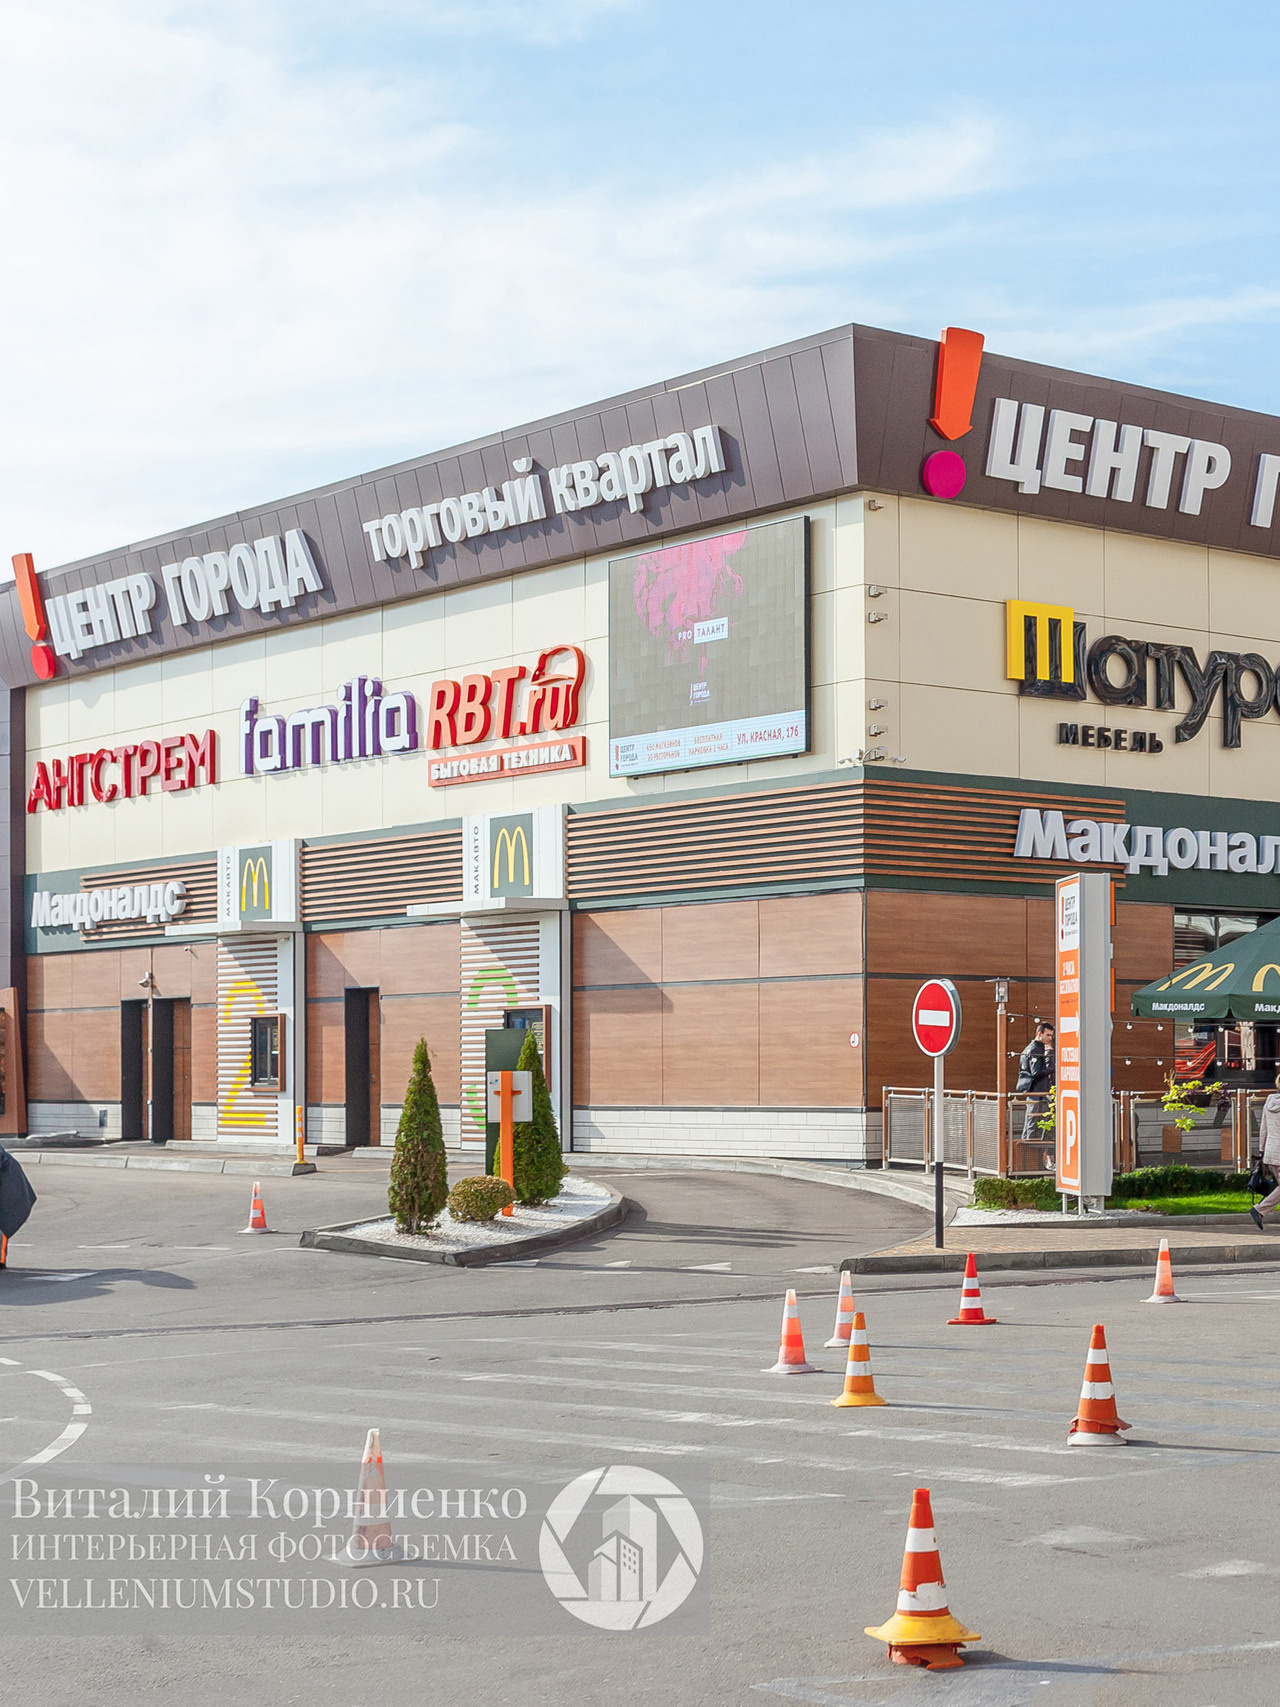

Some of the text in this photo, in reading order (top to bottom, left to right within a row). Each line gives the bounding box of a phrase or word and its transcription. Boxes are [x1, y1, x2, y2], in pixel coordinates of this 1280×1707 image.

[986, 397, 1231, 515] ЦЕНТР
[363, 424, 726, 569] торговый квартал
[45, 528, 324, 660] ЦЕНТР ГОРОДА
[239, 674, 419, 777] familia
[426, 664, 574, 750] RBT.ru
[737, 726, 799, 745] УЛ. КРАСНАЯ, 176
[1057, 722, 1164, 754] МЕБЕЛЬ
[27, 728, 220, 813] АНГСТРЕМ
[431, 744, 573, 780] БЫТОВАЯ ТЕХНИКА
[31, 881, 187, 931] Макдоналдс
[1152, 1002, 1205, 1012] Макдоналдс
[1066, 1110, 1076, 1165] P
